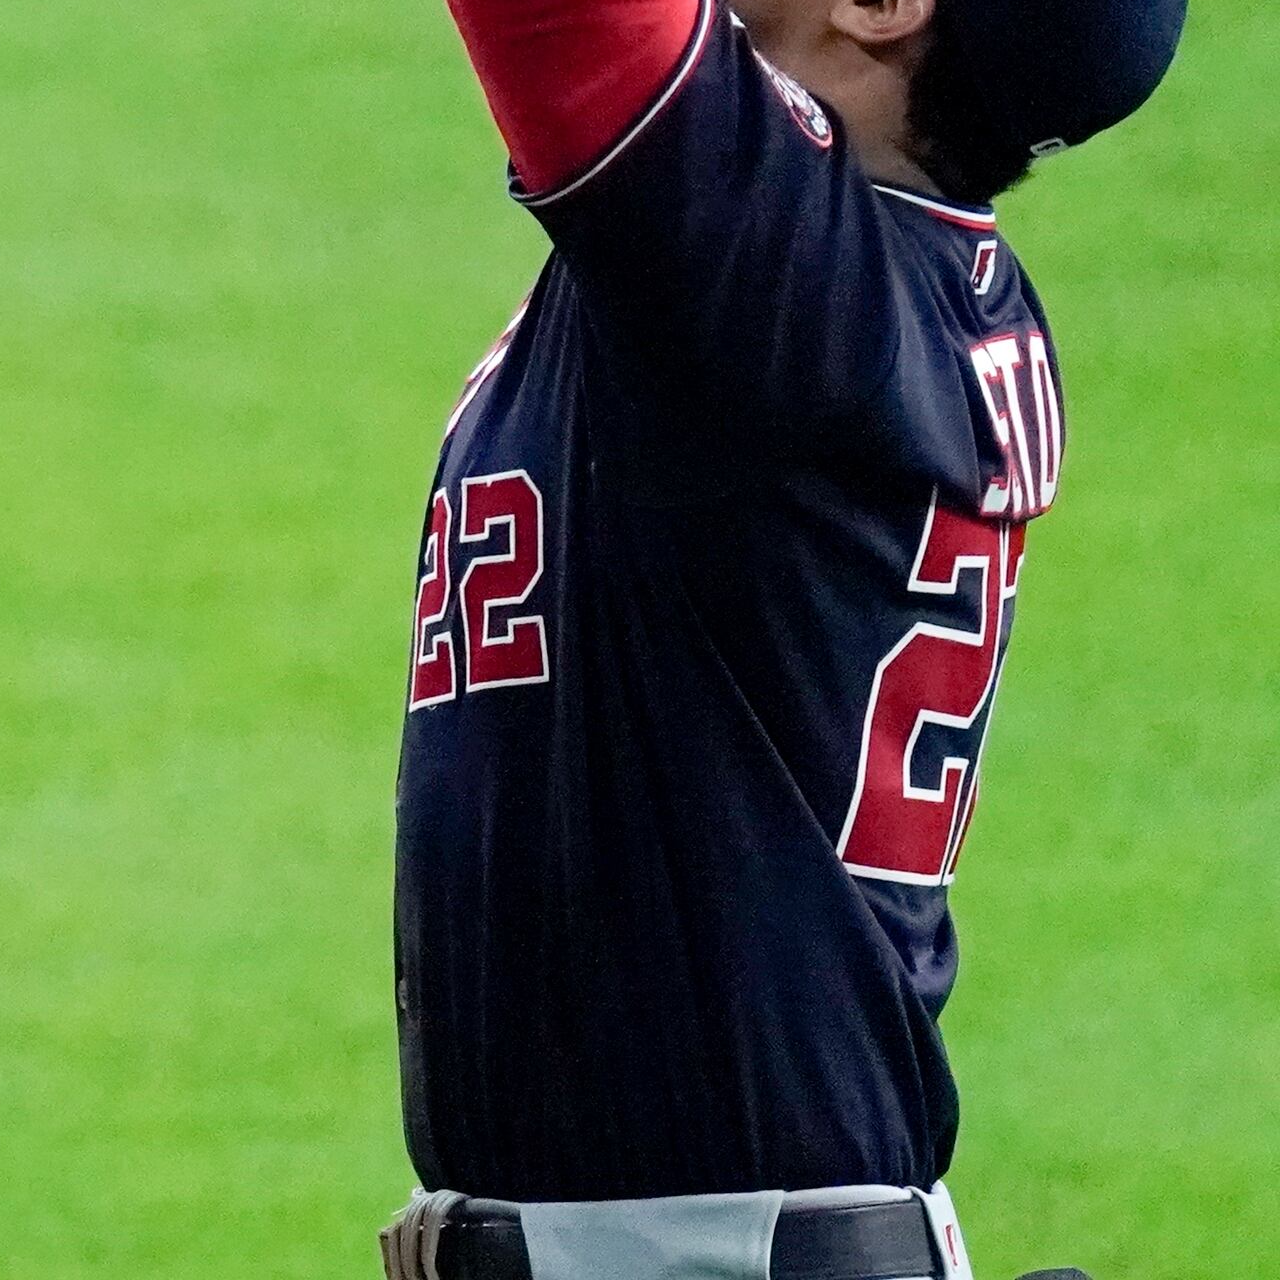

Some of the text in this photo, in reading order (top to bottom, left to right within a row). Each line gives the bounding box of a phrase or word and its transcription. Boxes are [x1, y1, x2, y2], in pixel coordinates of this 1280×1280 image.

[969, 329, 1063, 518] STO
[408, 468, 549, 712] 22
[837, 484, 1029, 886] 2
